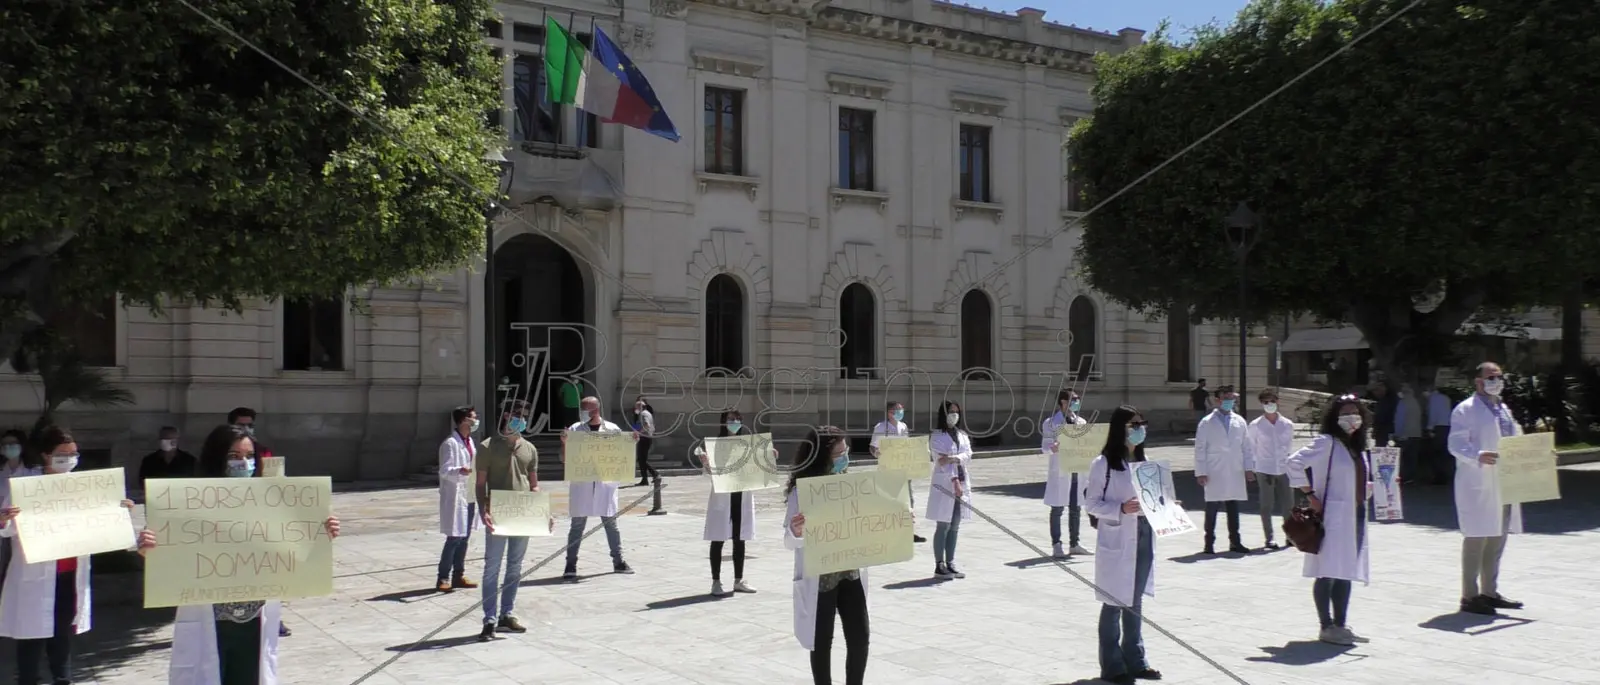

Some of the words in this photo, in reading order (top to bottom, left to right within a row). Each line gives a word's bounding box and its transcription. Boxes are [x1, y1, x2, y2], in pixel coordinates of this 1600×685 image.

[22, 481, 46, 498] LA
[49, 474, 117, 494] NOSTRA
[155, 486, 178, 511] 1
[184, 485, 258, 510] BORSA
[264, 484, 320, 508] OGGI
[809, 475, 877, 505] MEDICI
[32, 494, 111, 515] BATTAGLIA
[841, 500, 859, 518] IN
[157, 520, 178, 547] 1
[181, 519, 332, 545] SPECIALISTA
[805, 511, 912, 547] MOBILITAZIONE
[196, 550, 296, 579] DOMANI
